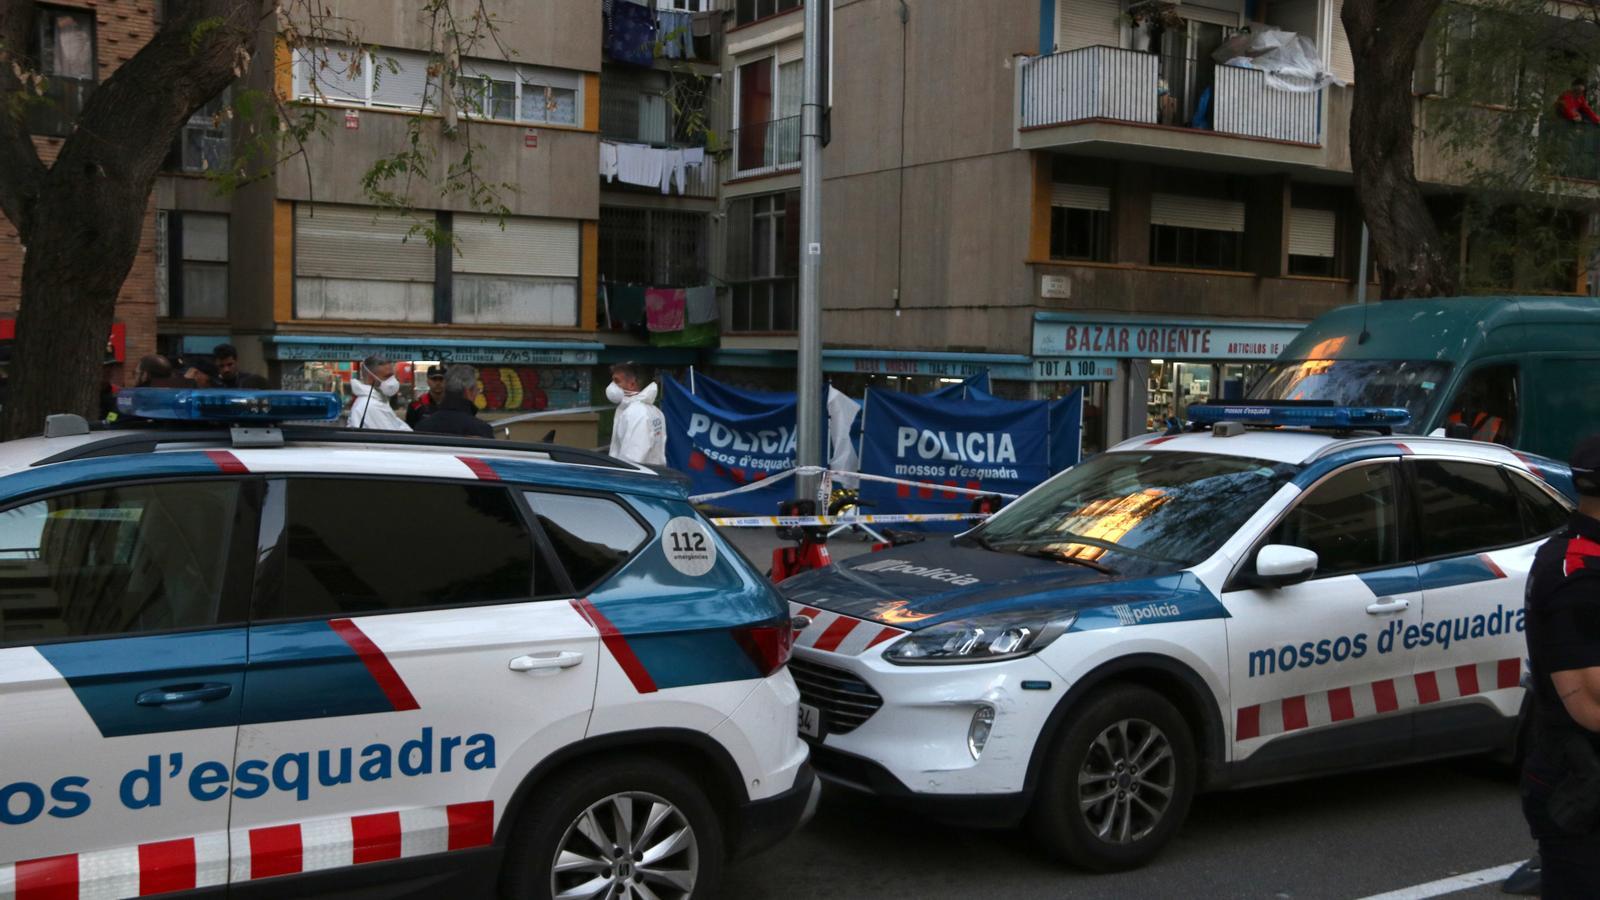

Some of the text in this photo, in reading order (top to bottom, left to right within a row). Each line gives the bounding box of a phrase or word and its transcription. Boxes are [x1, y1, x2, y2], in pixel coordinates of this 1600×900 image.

[1065, 326, 1130, 352] BAZAR
[1137, 327, 1211, 353] ORIENTE
[1228, 343, 1266, 354] ARTICULOS
[1039, 361, 1060, 377] TOT
[1064, 361, 1072, 376] A
[1078, 361, 1095, 376] 100
[687, 413, 797, 454] POLICIA
[897, 426, 1017, 463] POLICIA
[895, 464, 1018, 480] mossos d'esquadra
[671, 532, 706, 551] 112
[880, 563, 980, 586] policia
[1133, 603, 1180, 622] policia
[1249, 604, 1526, 677] mossos d'esquadra
[119, 727, 497, 810] d'esquadra
